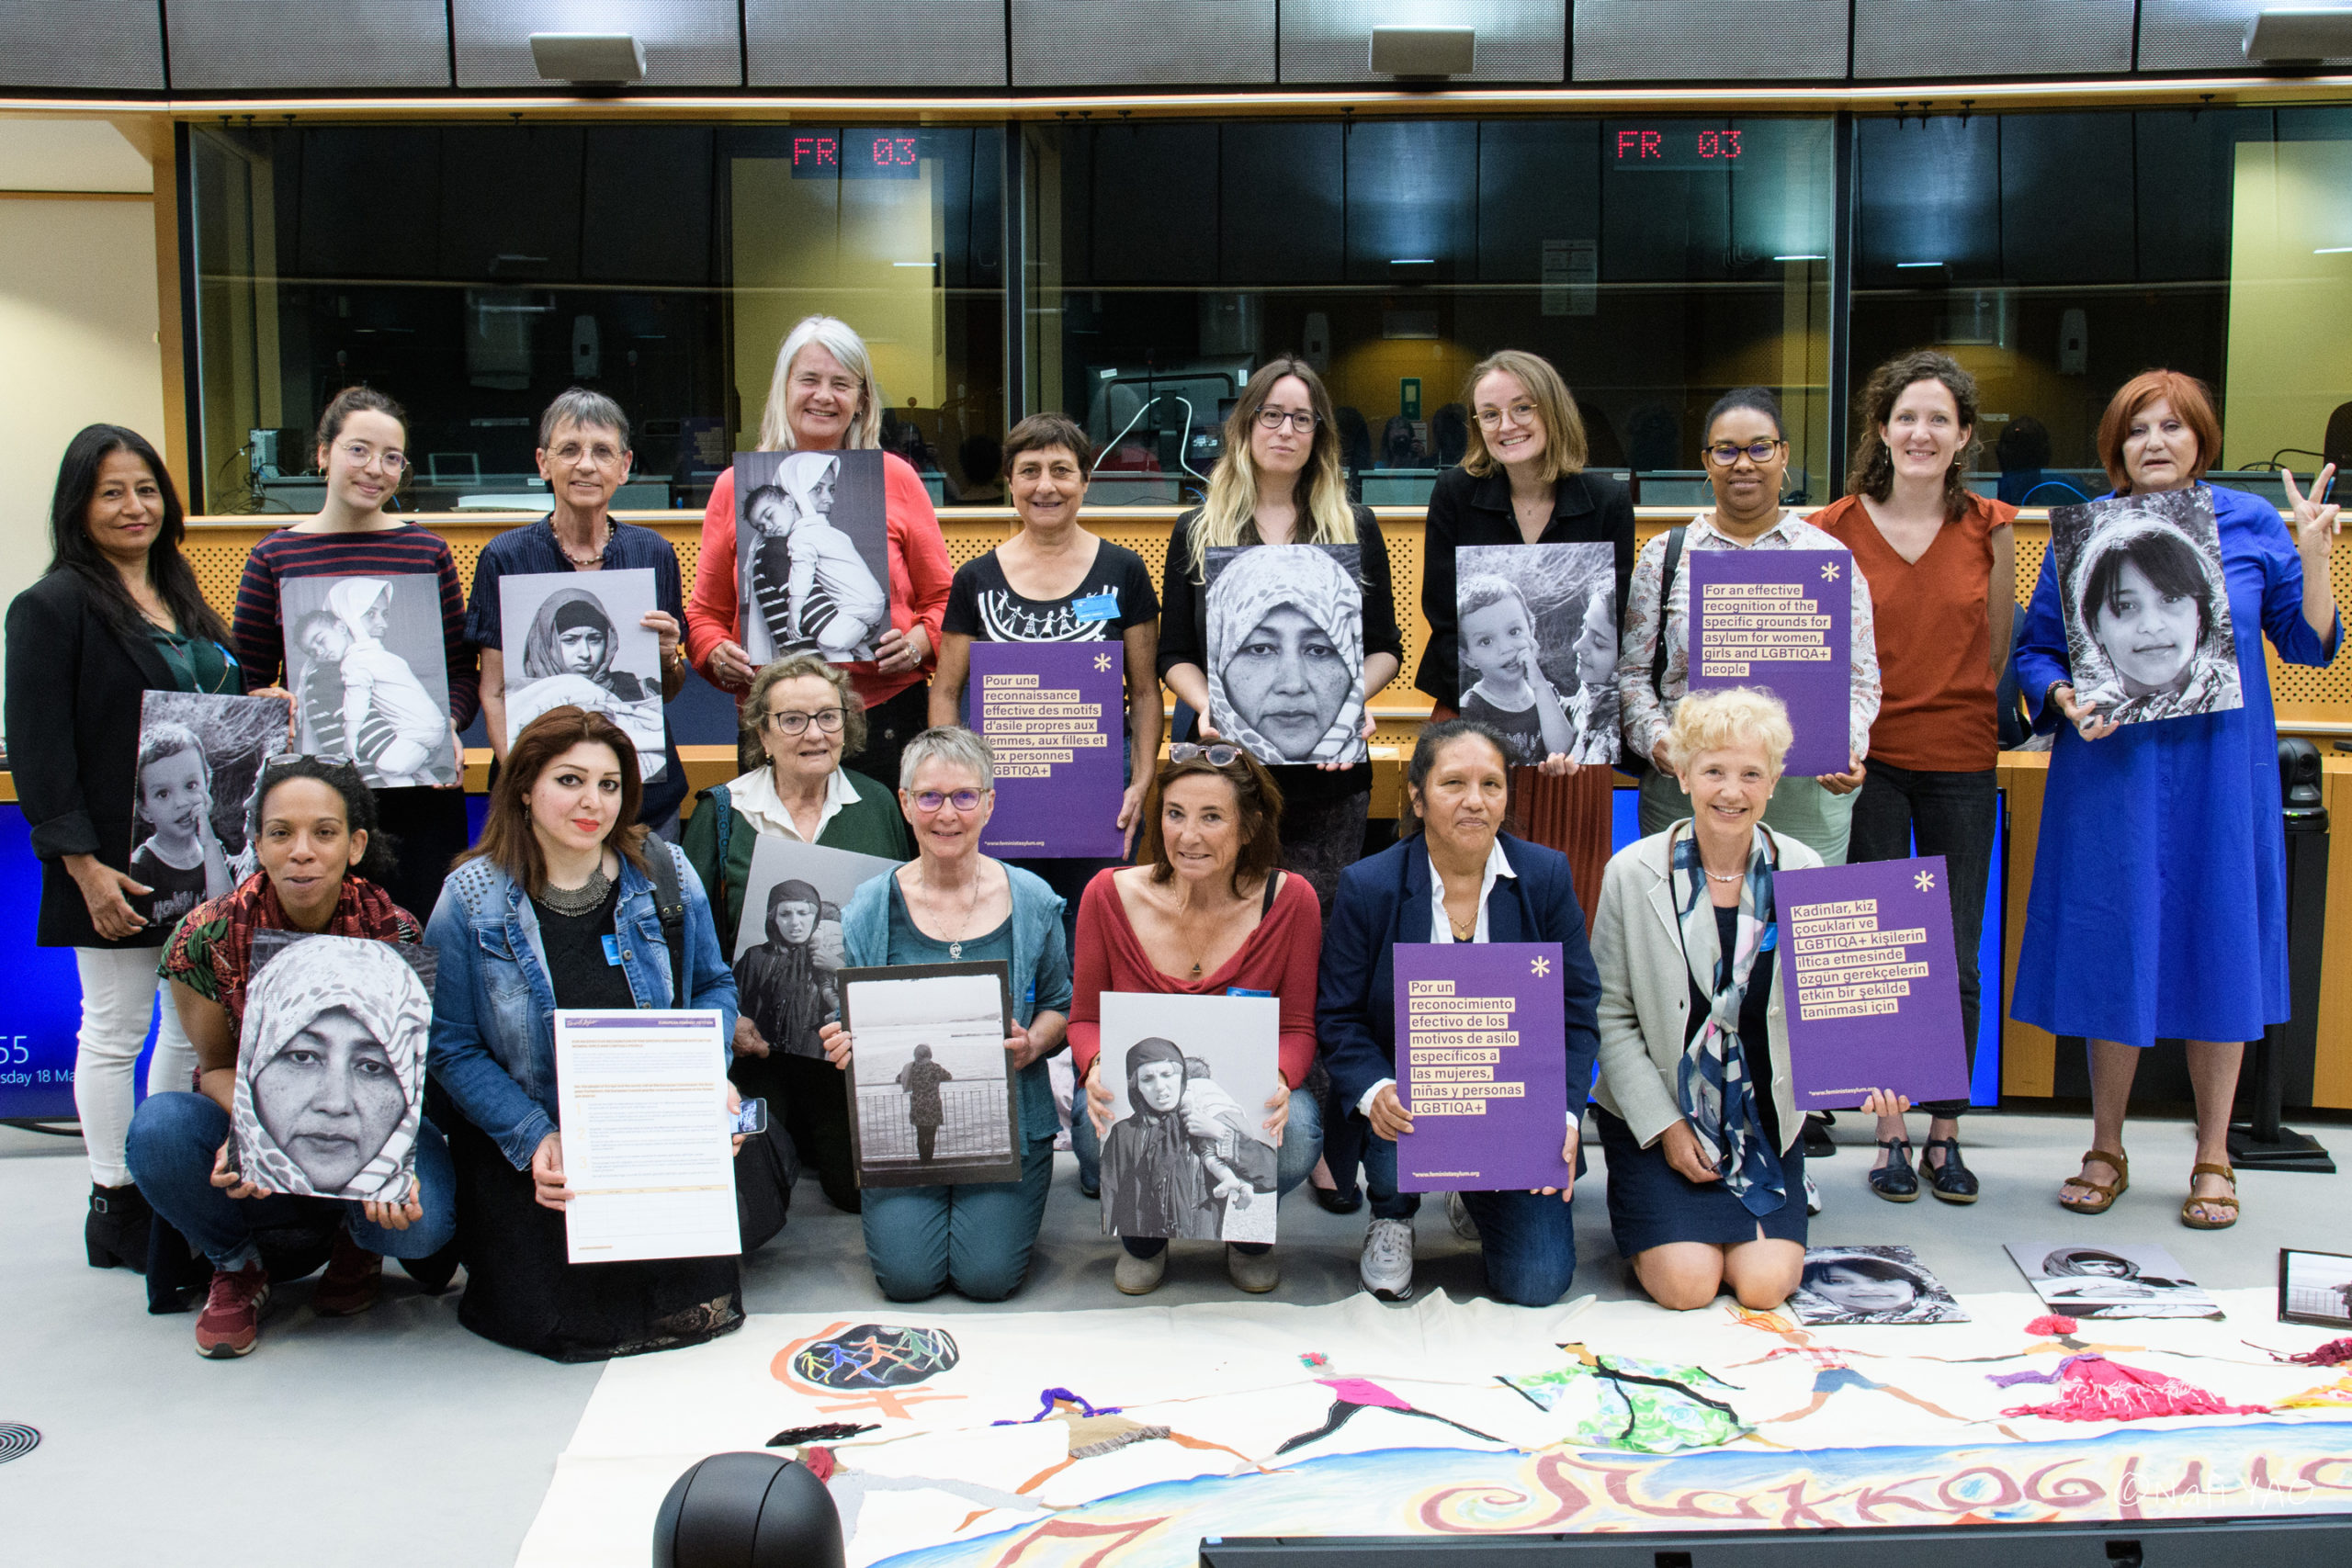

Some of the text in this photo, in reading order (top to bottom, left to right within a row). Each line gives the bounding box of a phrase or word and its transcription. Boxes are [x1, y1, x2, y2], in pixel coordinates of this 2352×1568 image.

[1618, 130, 1742, 158] FR 03
[794, 138, 916, 165] FR 03
[1705, 585, 1800, 595] For an effective
[1705, 601, 1814, 613] recognition of the
[1705, 616, 1827, 629] specific grounds for
[1705, 632, 1820, 645] asylum for women,
[1704, 649, 1827, 660] girls and LGBTIQA+
[1704, 664, 1746, 676] people
[986, 676, 1012, 685] Pour
[986, 691, 1077, 700] reconnaissance
[986, 705, 1099, 715] effective des motifs
[986, 721, 1094, 732] d'asile propres aux
[986, 735, 1103, 746] femmes, aux filles et
[993, 751, 1070, 762] ux personnes
[994, 766, 1048, 775] GBTIQA+
[1793, 900, 1873, 918] Kadinlar, kiz
[1795, 919, 1873, 937] çocuklari ve
[1871, 930, 1923, 946] kişilerin
[1798, 949, 1903, 967] iltica etmesinde
[1800, 964, 1926, 986] özgün gerekçelerin
[1411, 983, 1453, 992] Por un
[1802, 983, 1906, 1000] etkin bir şekilde
[1411, 998, 1511, 1010] reconocimiento
[1804, 1000, 1894, 1018] taninmasi için
[1412, 1016, 1505, 1027] efectivo de los
[1412, 1032, 1516, 1043] motivos de asilo
[1412, 1050, 1497, 1064] específicos a
[0, 1069, 32, 1087] sday
[37, 1069, 51, 1083] 18
[1413, 1068, 1490, 1081] las mujeres,
[1413, 1085, 1521, 1098] niñas y personas
[1414, 1102, 1483, 1113] LGBTIQA+
